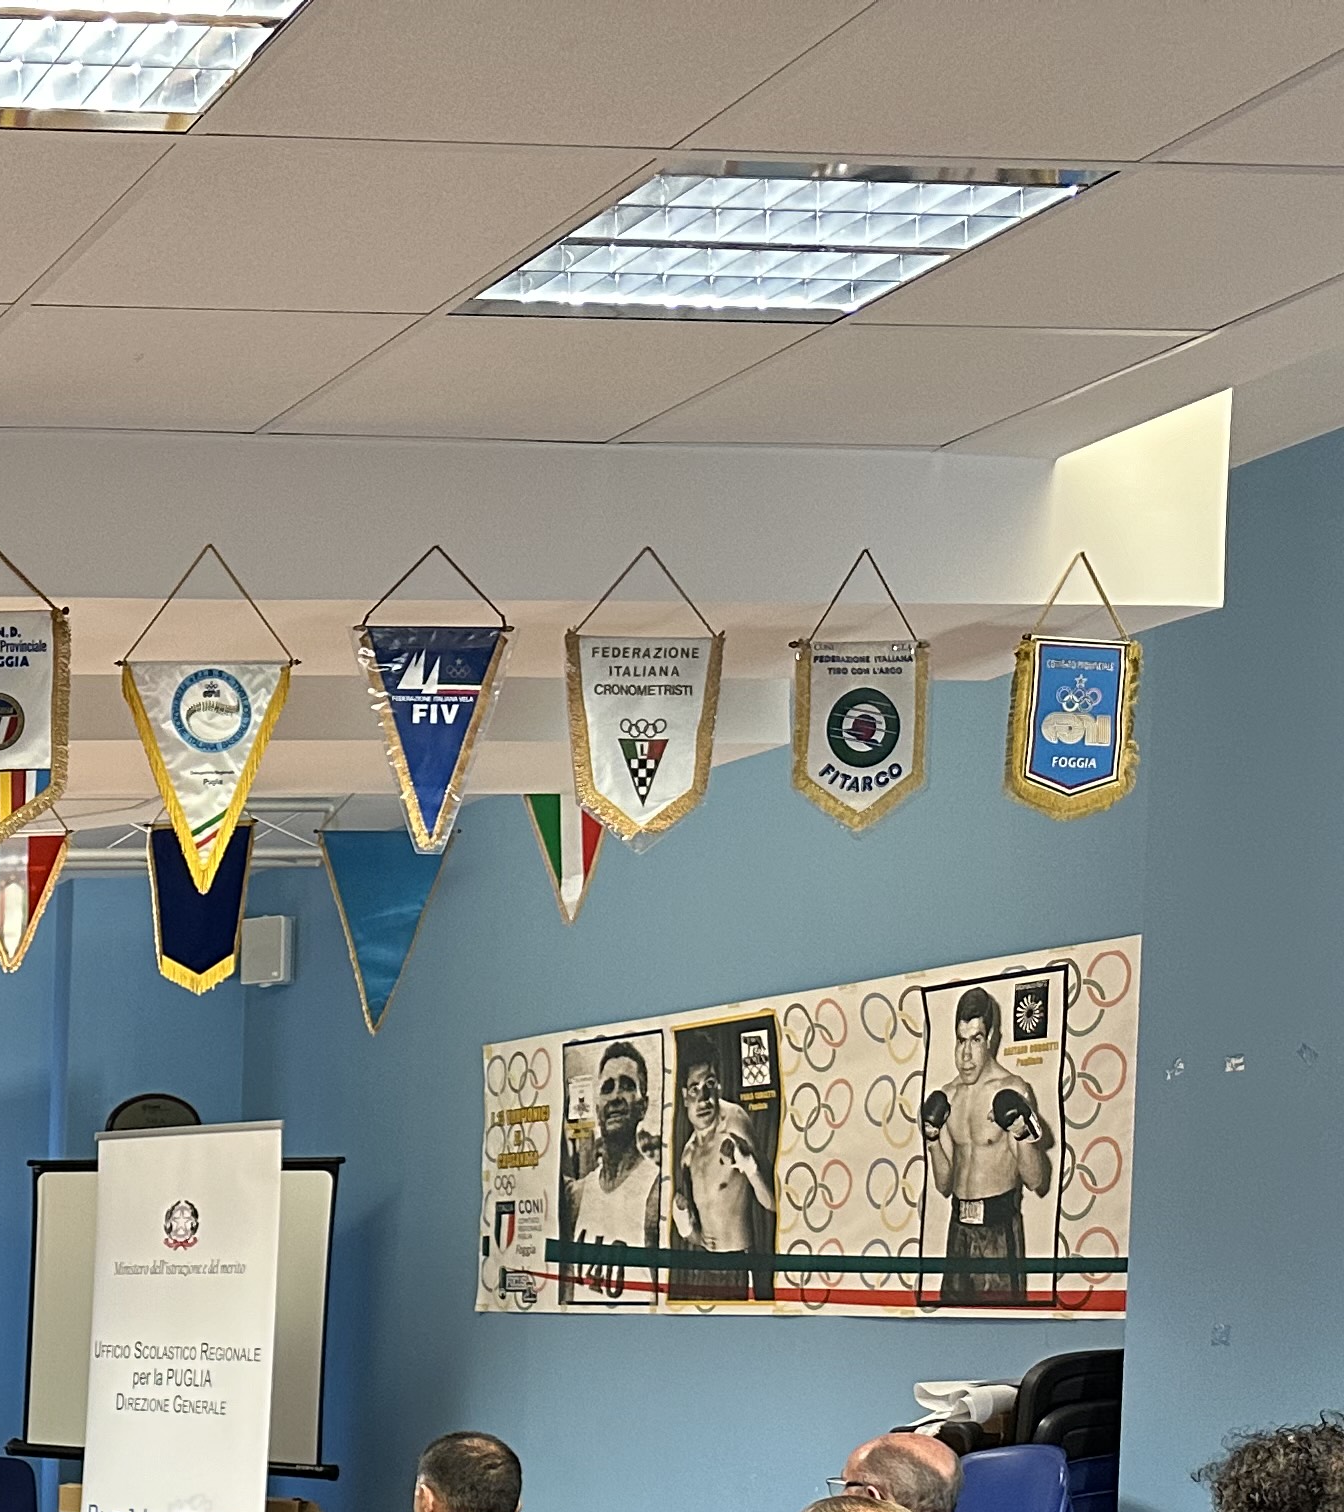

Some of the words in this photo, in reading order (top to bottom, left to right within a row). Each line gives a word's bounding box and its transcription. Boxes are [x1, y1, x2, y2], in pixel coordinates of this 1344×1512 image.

[0, 640, 47, 653] Provinciale
[591, 646, 700, 659] FEDERAZIONE
[813, 655, 871, 664] FEDERAZIONE
[874, 655, 914, 663] ITALIANA
[608, 665, 680, 677] ITALIANA
[850, 667, 870, 675] CON
[593, 683, 693, 696] CRONOMETRISTI
[412, 703, 460, 725] FIV
[1051, 756, 1097, 769] FOGGIA
[818, 762, 903, 793] FITARCO
[518, 1198, 544, 1214] CONI
[93, 1340, 131, 1359] UFFICIO
[133, 1341, 197, 1361] SCOLASTICO
[200, 1342, 262, 1362] REGIONALE
[132, 1371, 152, 1389] per
[153, 1368, 163, 1386] la
[166, 1368, 213, 1388] PUGLIA
[115, 1392, 170, 1413] DIREZIONE
[172, 1394, 227, 1416] GENERALE
